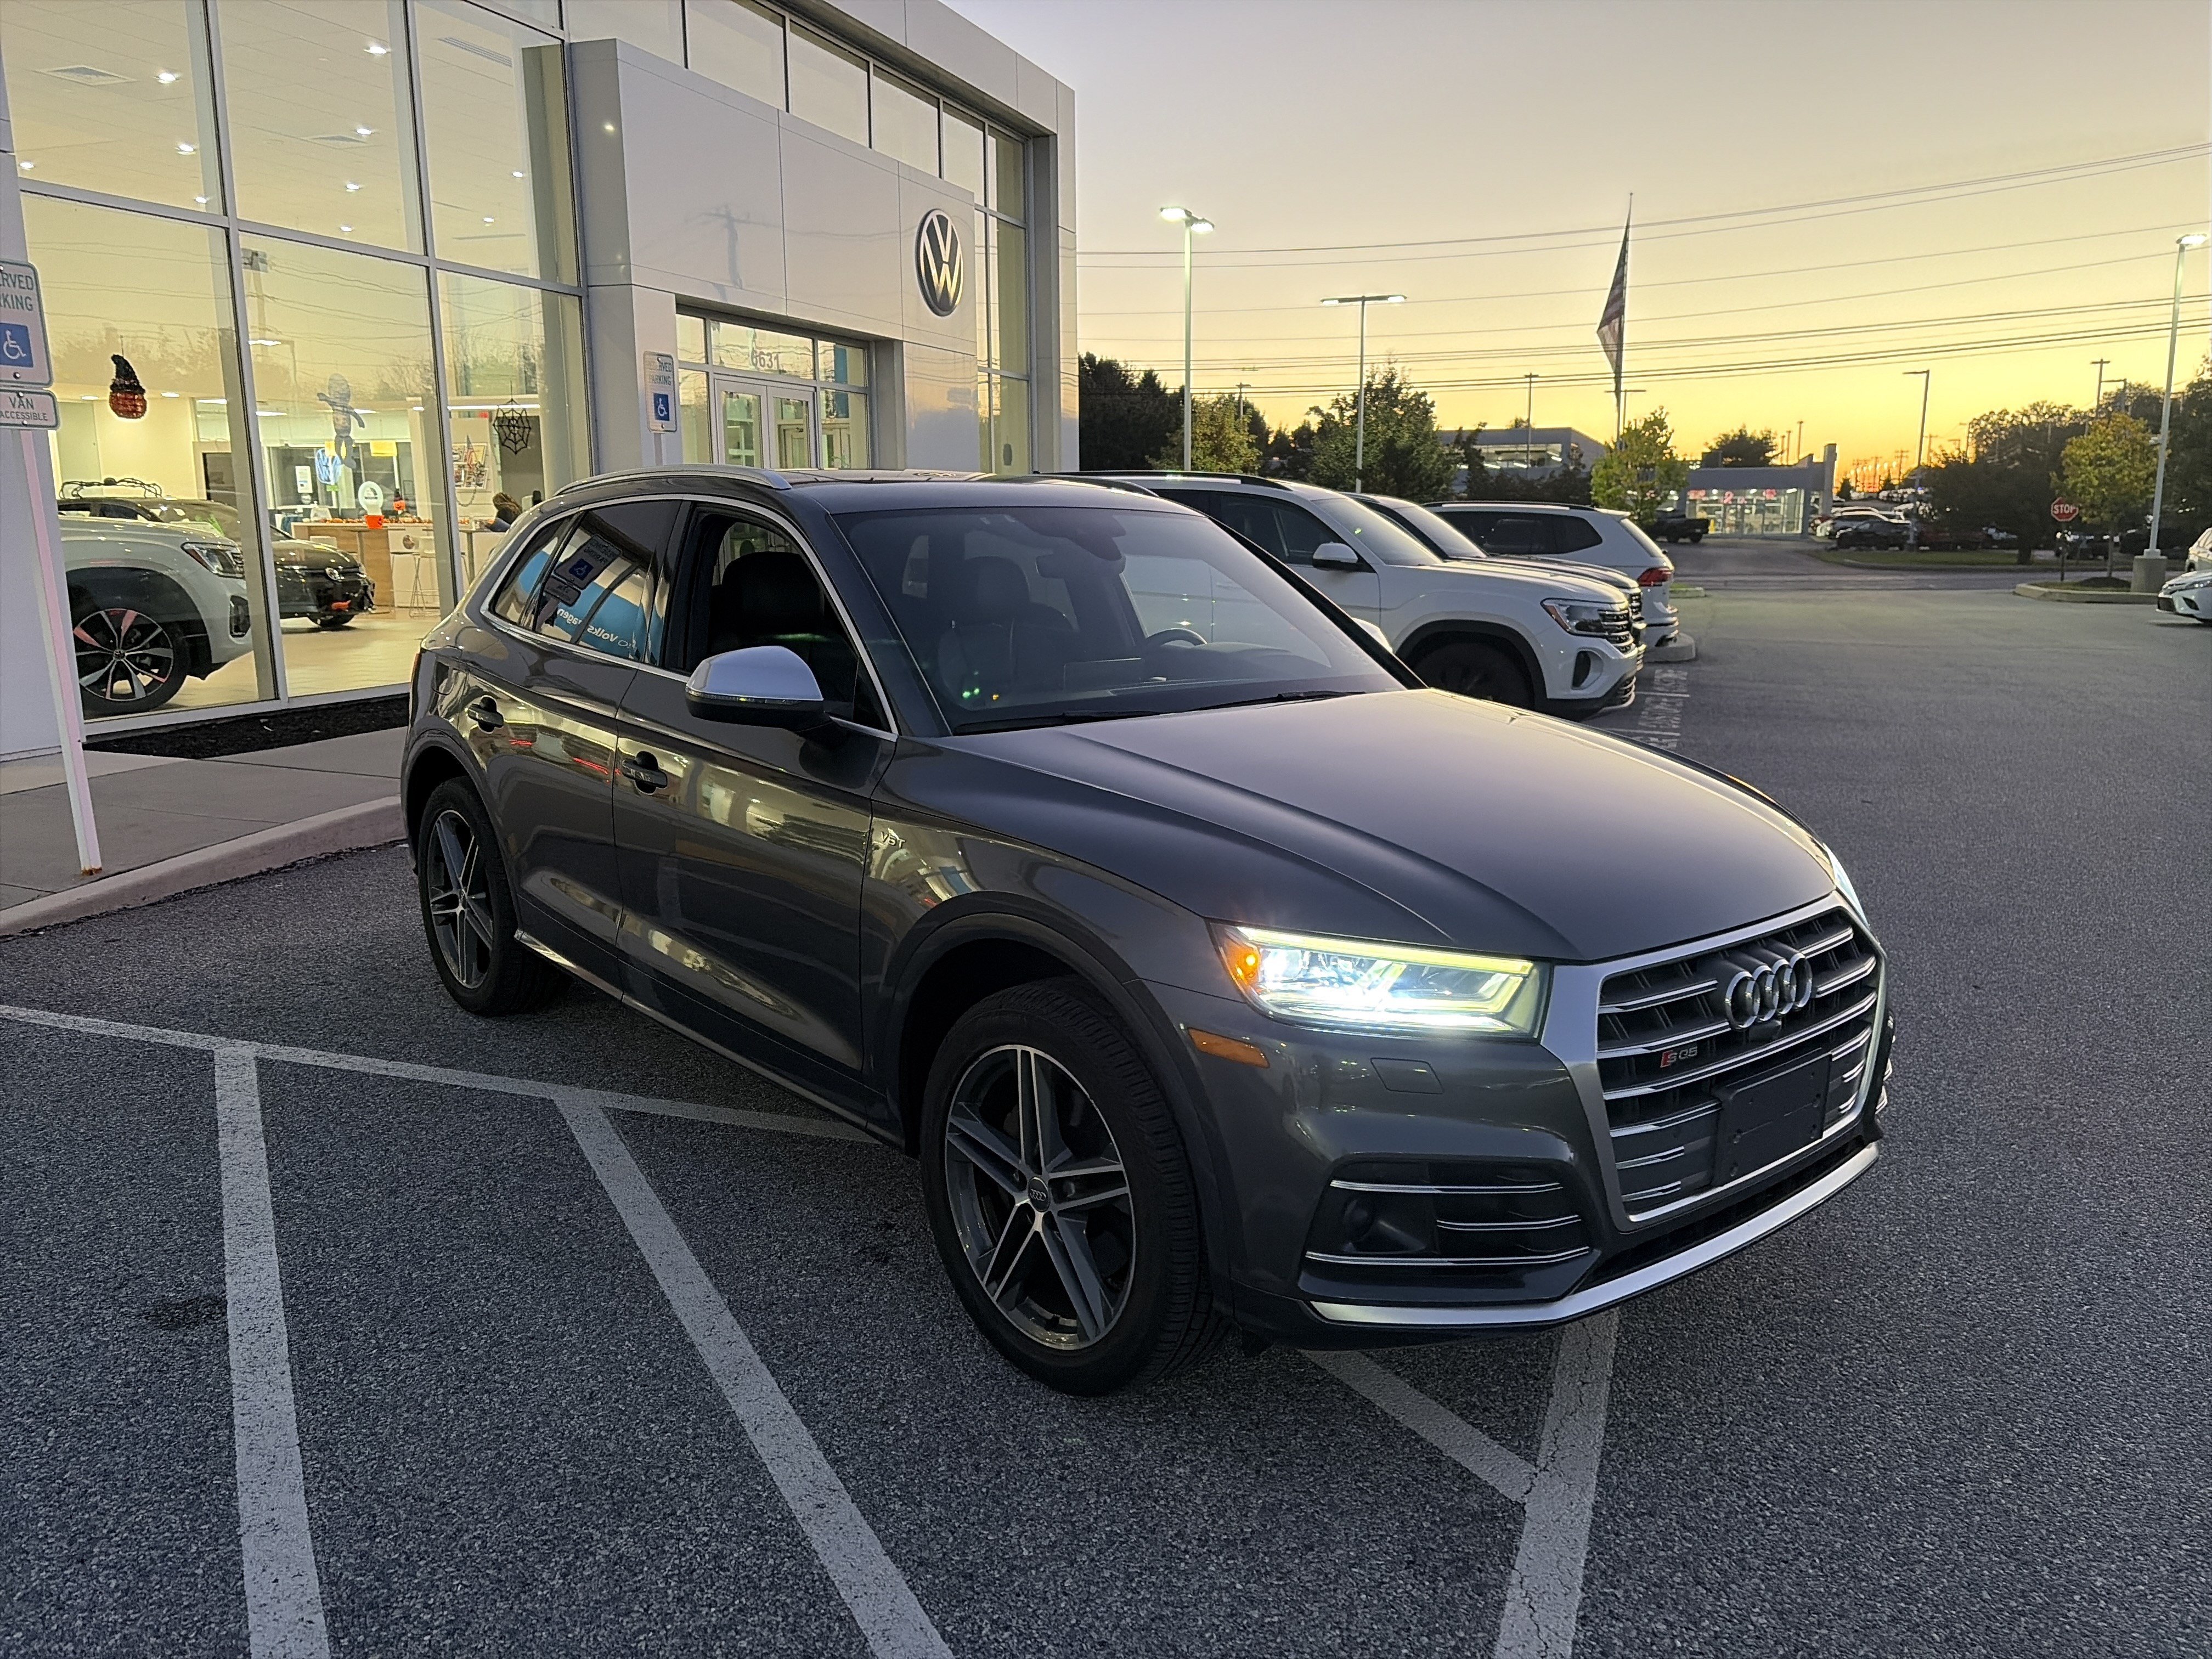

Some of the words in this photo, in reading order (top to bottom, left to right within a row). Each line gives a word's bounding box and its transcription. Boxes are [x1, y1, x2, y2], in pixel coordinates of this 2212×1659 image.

[0, 272, 33, 290] RVED
[0, 293, 33, 312] KING
[9, 396, 34, 410] VAN
[0, 410, 48, 421] ACCESSIBLE
[881, 831, 906, 848] V6T
[1662, 1046, 1698, 1066] SQ5
